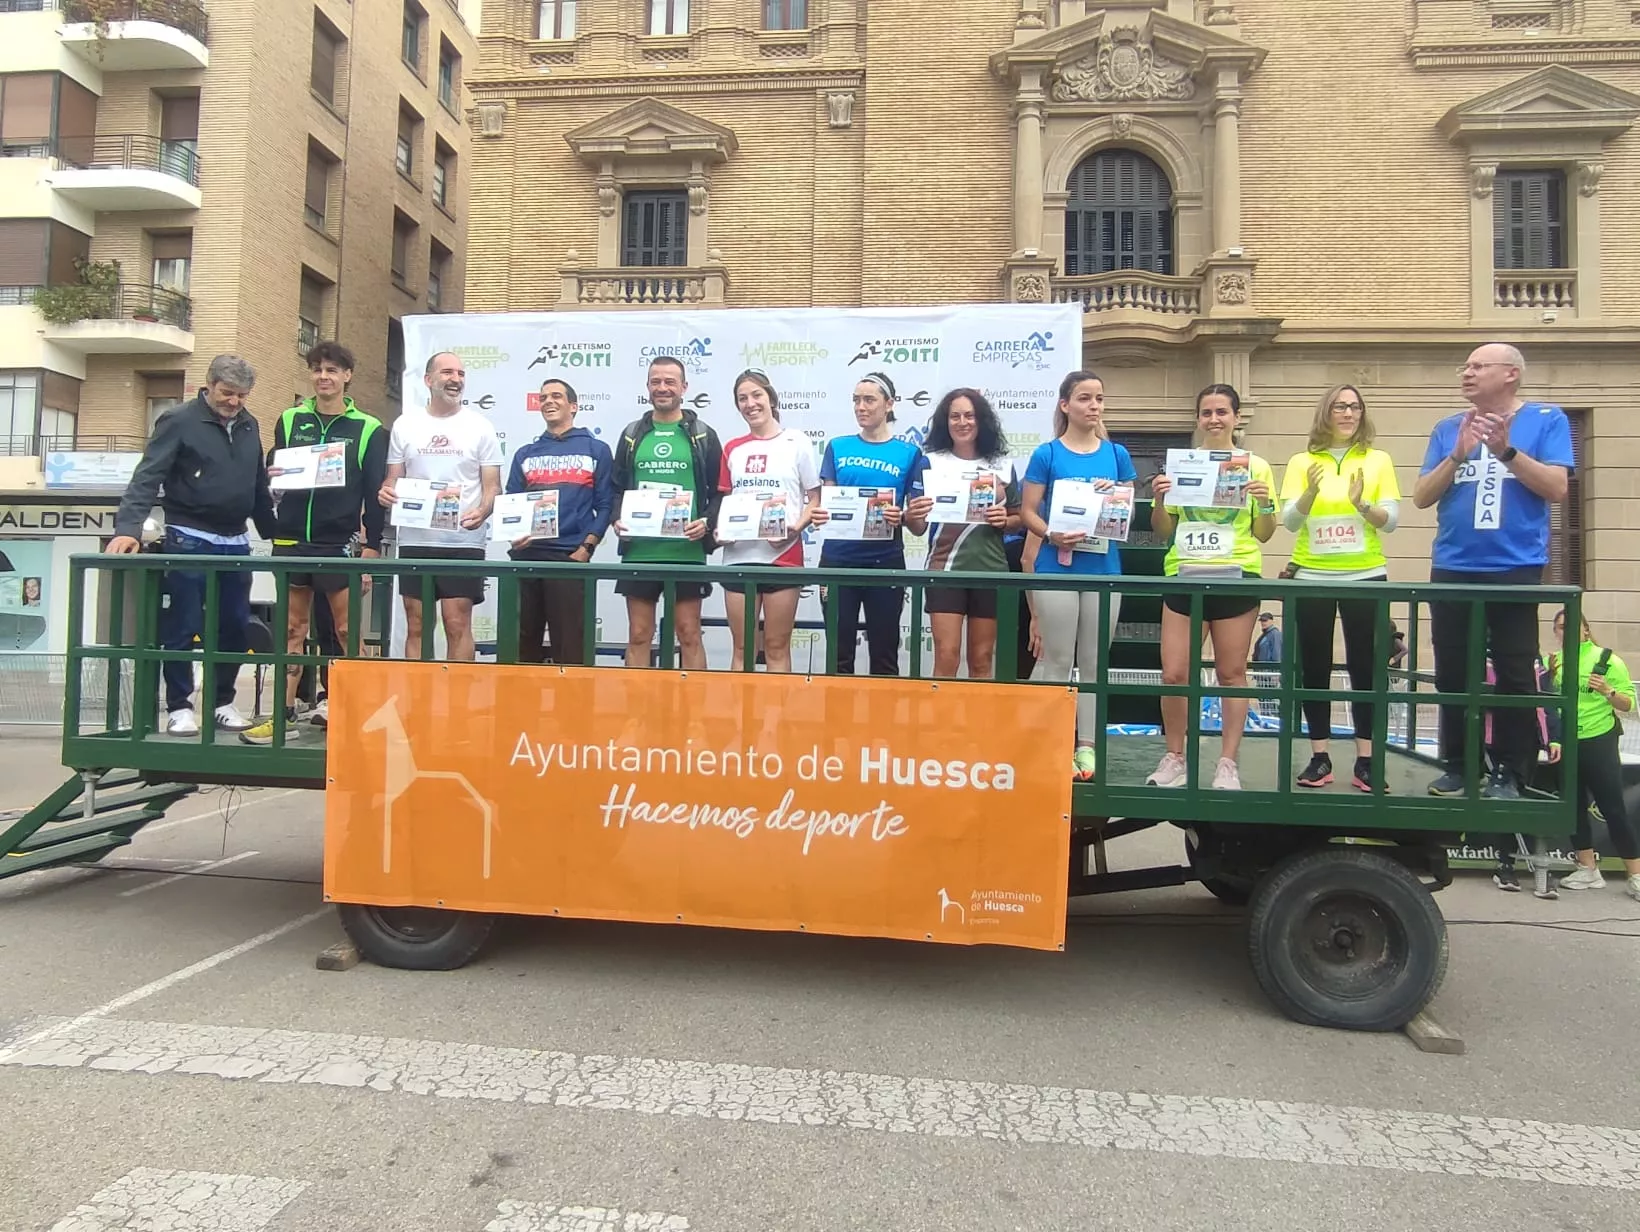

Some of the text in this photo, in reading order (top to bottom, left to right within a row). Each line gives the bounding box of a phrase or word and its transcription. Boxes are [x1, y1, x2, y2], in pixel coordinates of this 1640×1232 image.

[884, 337, 939, 346] ATLETISMO
[975, 341, 1040, 351] CARRERA
[640, 346, 700, 356] CARRERA
[882, 347, 939, 363] ZOITI
[559, 352, 611, 367] ZOITI
[769, 355, 816, 365] SPORT
[972, 352, 1042, 363] EMPRESAS
[464, 360, 498, 369] PORT
[983, 388, 1055, 399] Ayuntamiento
[998, 400, 1037, 409] Huesca
[638, 461, 688, 470] CABRERO
[846, 456, 901, 477] COGITIAR
[1316, 525, 1356, 538] 1104
[1185, 532, 1220, 546] 116
[509, 731, 1015, 790] Ayuntamiento de Huesca
[599, 783, 909, 855] Hacemos deporte
[970, 889, 1042, 904] Ayuntamiento
[970, 900, 1025, 913] de Huesca
